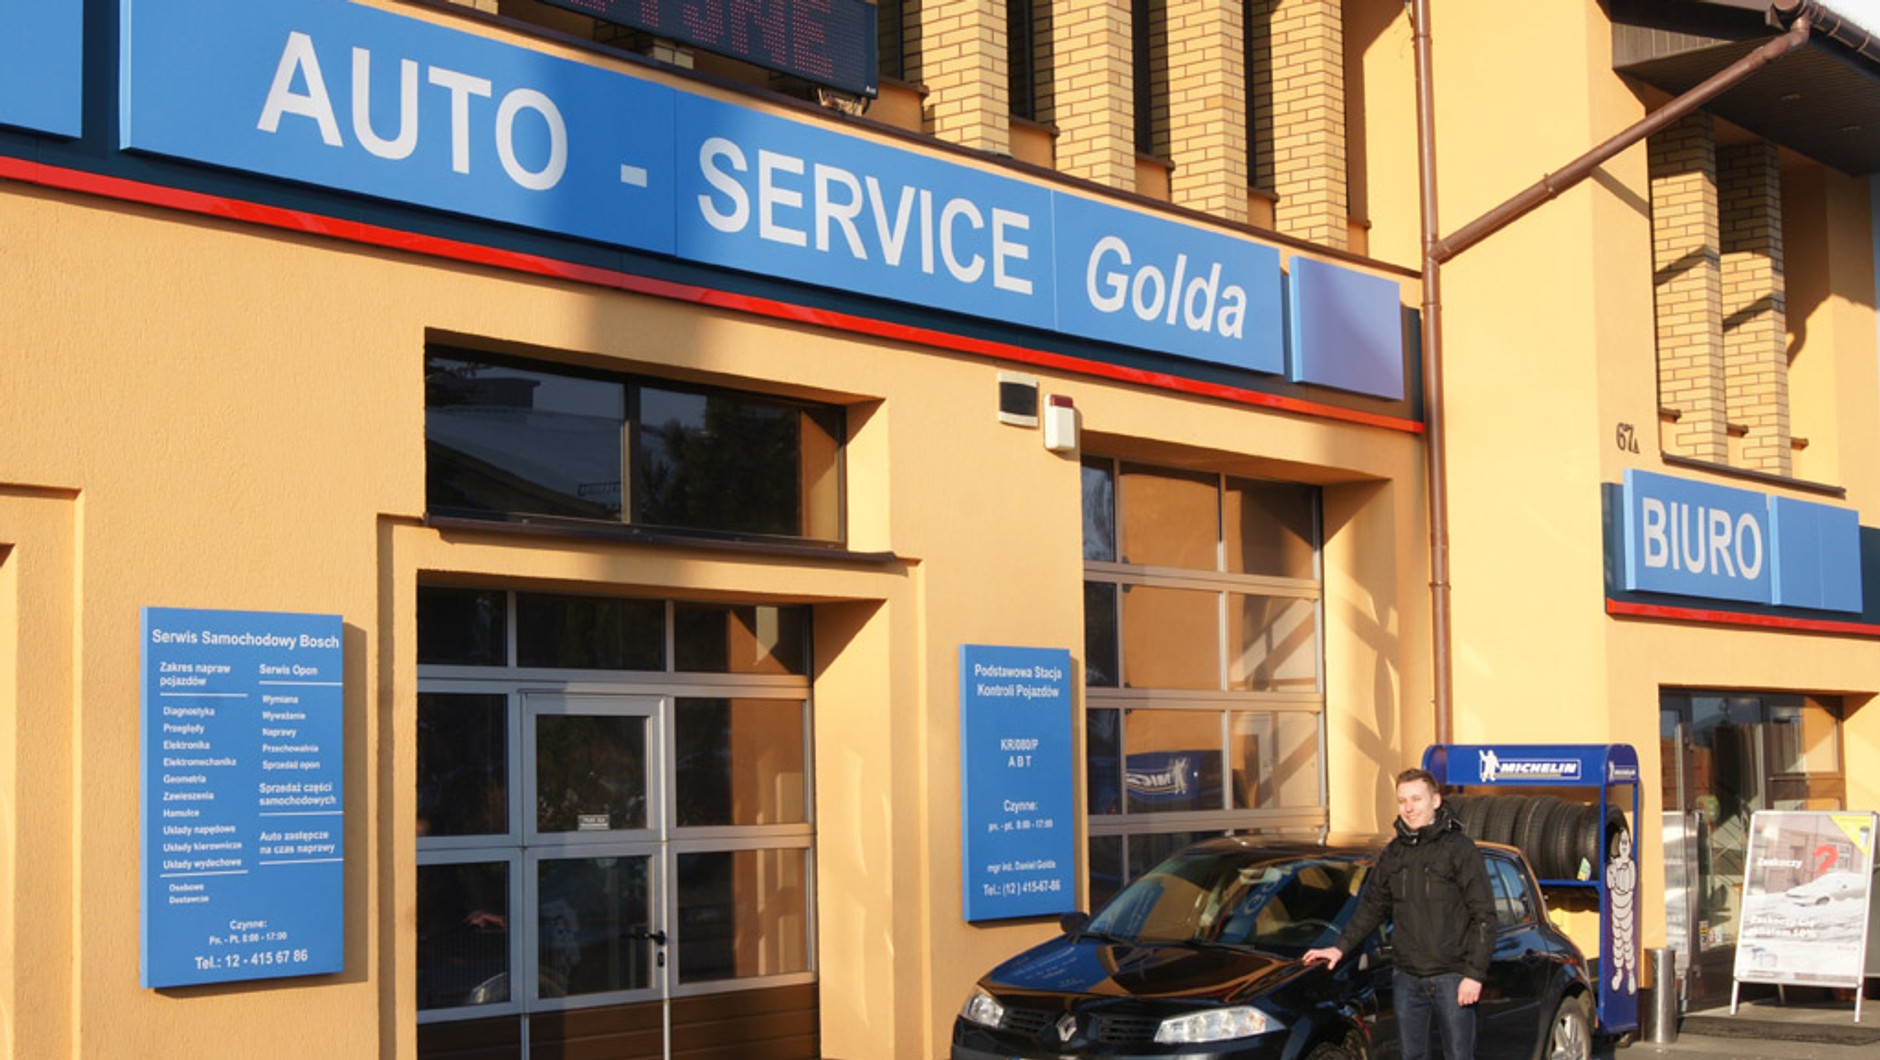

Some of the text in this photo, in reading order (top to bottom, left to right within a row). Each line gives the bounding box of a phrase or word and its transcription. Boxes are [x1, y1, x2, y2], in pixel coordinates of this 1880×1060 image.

[256, 30, 1248, 340] AUTO - SERVICE Golda
[1642, 496, 1764, 580] BIURO
[152, 629, 340, 650] Serwis Samochodowy Bosch
[160, 661, 231, 675] Zakres napraw
[259, 664, 318, 676] Serwis Opon
[974, 663, 1063, 681] Podstawowa Stacja
[160, 676, 206, 687] pojazdów
[976, 684, 1060, 700] Kontroli Pojazdów
[163, 706, 215, 718] Diagnostyka
[163, 740, 211, 750] Elektronika
[163, 757, 237, 767] Elektromechanika
[1007, 755, 1017, 768] A
[1025, 755, 1033, 768] T
[1500, 763, 1577, 774] MICHELIN
[163, 774, 207, 784] Geometria
[259, 795, 336, 807] samochodowych
[1003, 799, 1039, 814] Czynne:
[163, 808, 200, 818] Hamulce
[260, 831, 282, 841] Auto
[260, 843, 336, 855] na czas naprawy
[983, 882, 1001, 897] Tel.:
[229, 920, 268, 932] Czynne:
[194, 956, 222, 970] Tel.:
[225, 953, 241, 969] 12
[250, 952, 274, 967] 415
[275, 950, 291, 964] 67
[293, 949, 309, 963] 86
